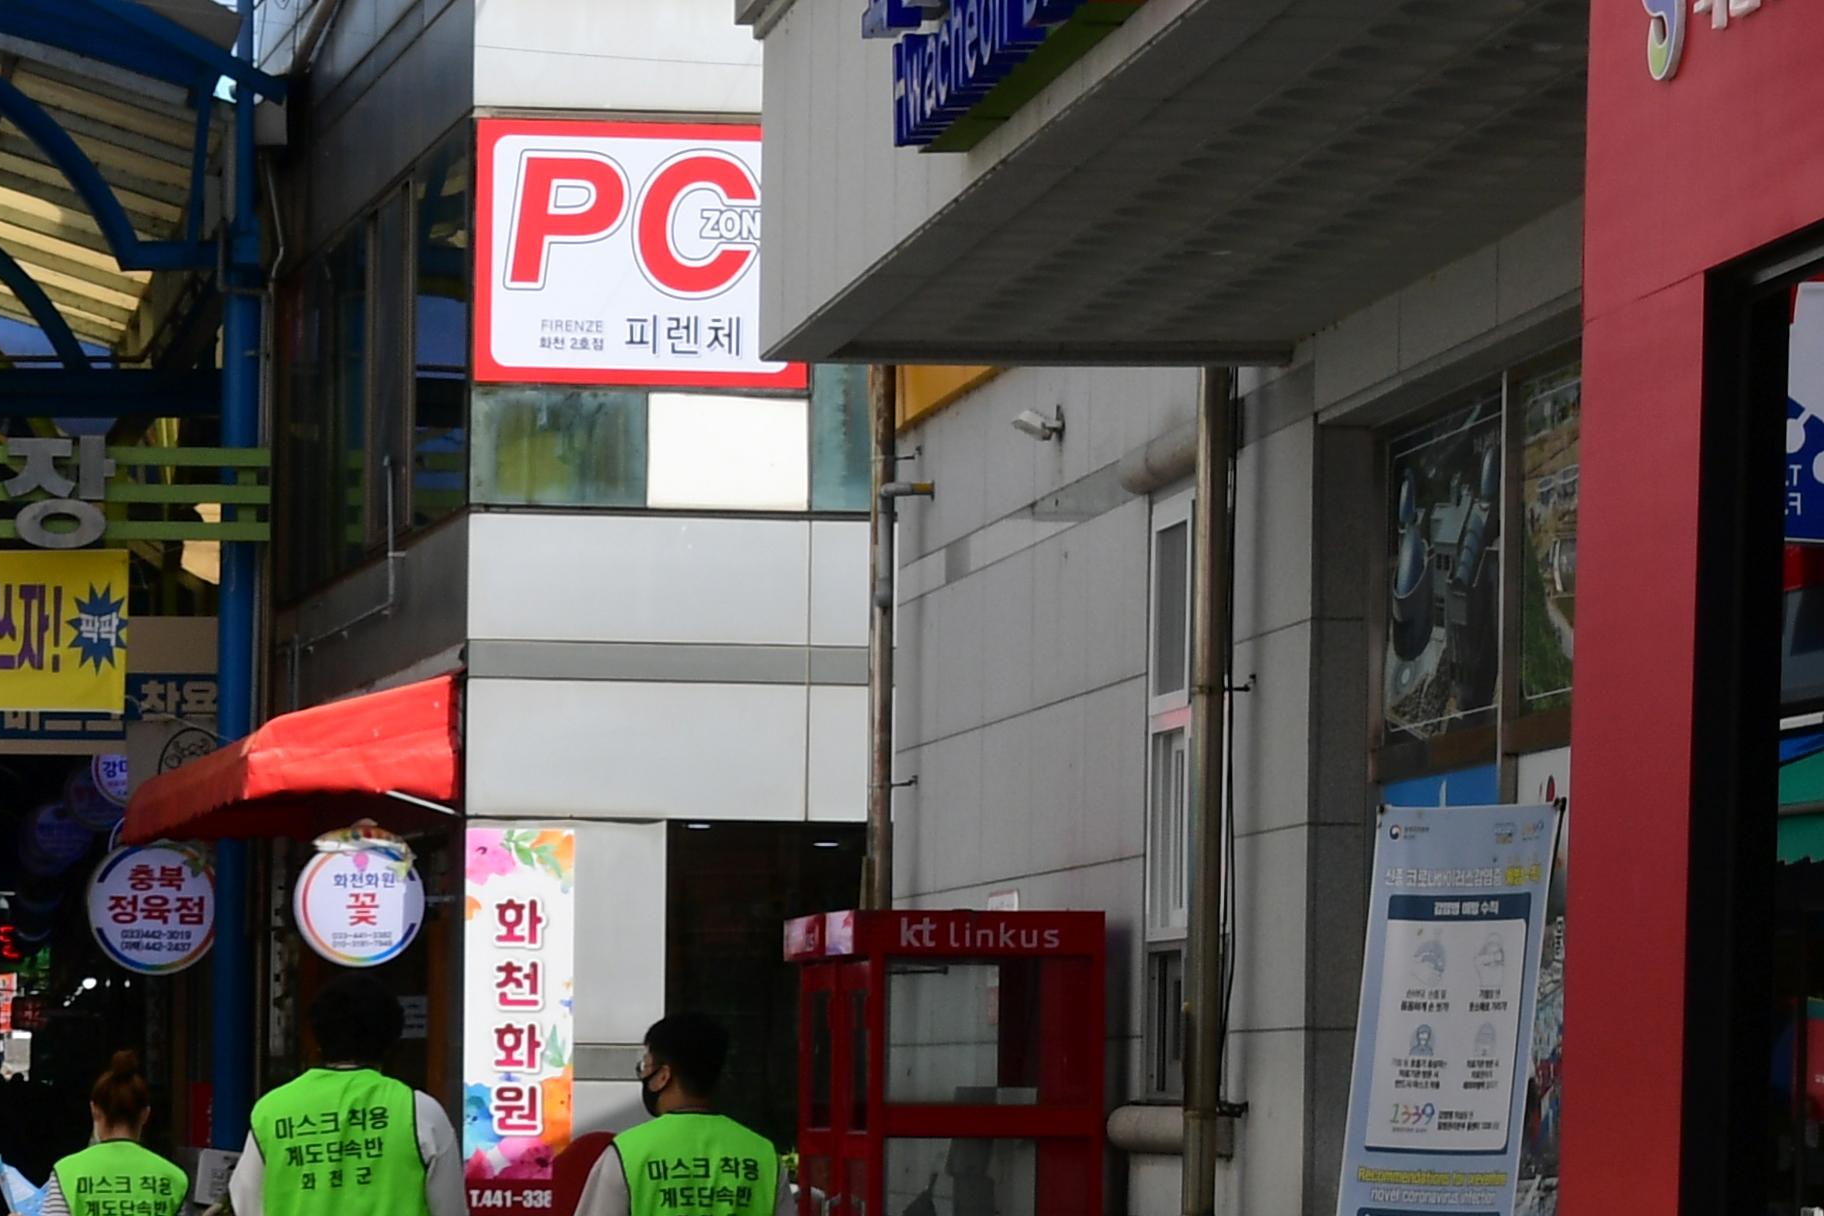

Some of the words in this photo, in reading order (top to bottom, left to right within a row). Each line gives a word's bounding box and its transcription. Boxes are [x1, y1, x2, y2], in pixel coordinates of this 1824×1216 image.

[504, 148, 762, 300] PC
[541, 320, 604, 333] FIRENZE
[625, 314, 742, 357] 피렌체
[539, 337, 565, 350] 화천
[570, 337, 604, 351] 2호점
[128, 863, 185, 892] 충북
[333, 872, 396, 889] 화천화원
[107, 894, 206, 925] 정육점
[346, 892, 380, 927] 꽃
[900, 916, 937, 947] kt
[949, 921, 1061, 948] linkus
[494, 898, 546, 1134] 화천화원
[275, 1111, 340, 1139] 마스크
[348, 1106, 389, 1131] 착용
[285, 1137, 384, 1167] 계도단속반
[647, 1157, 711, 1181] 마스크
[720, 1156, 759, 1181] 착용
[77, 1175, 132, 1195] 마스크
[140, 1175, 173, 1196] 착용
[659, 1186, 753, 1208] 계도단속반
